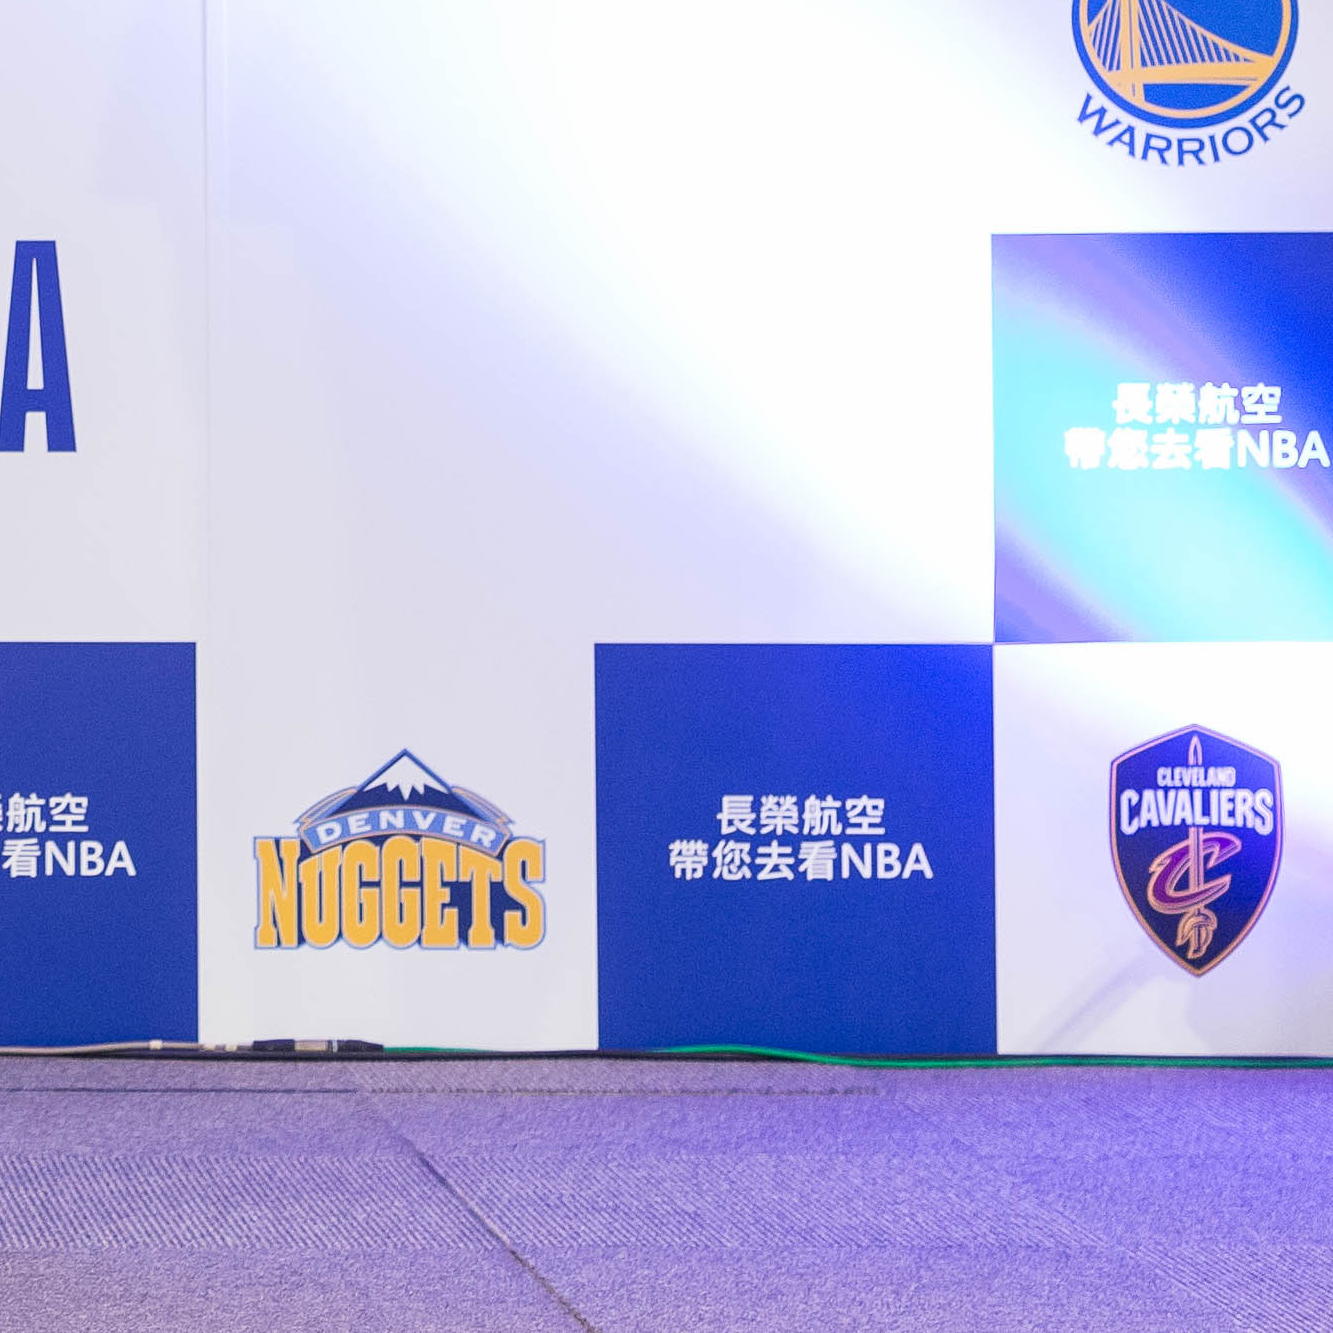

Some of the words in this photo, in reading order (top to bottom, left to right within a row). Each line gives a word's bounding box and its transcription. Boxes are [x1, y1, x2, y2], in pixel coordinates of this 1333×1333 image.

[1076, 84, 1306, 167] WARRIORS
[1156, 766, 1237, 788] CLEVELAND
[315, 809, 499, 850] DENVER
[716, 794, 886, 836] 長榮航空
[1120, 787, 1275, 836] CAVALIERS
[668, 839, 934, 881] 帶您去看NBA
[253, 834, 547, 951] NUGGETS
